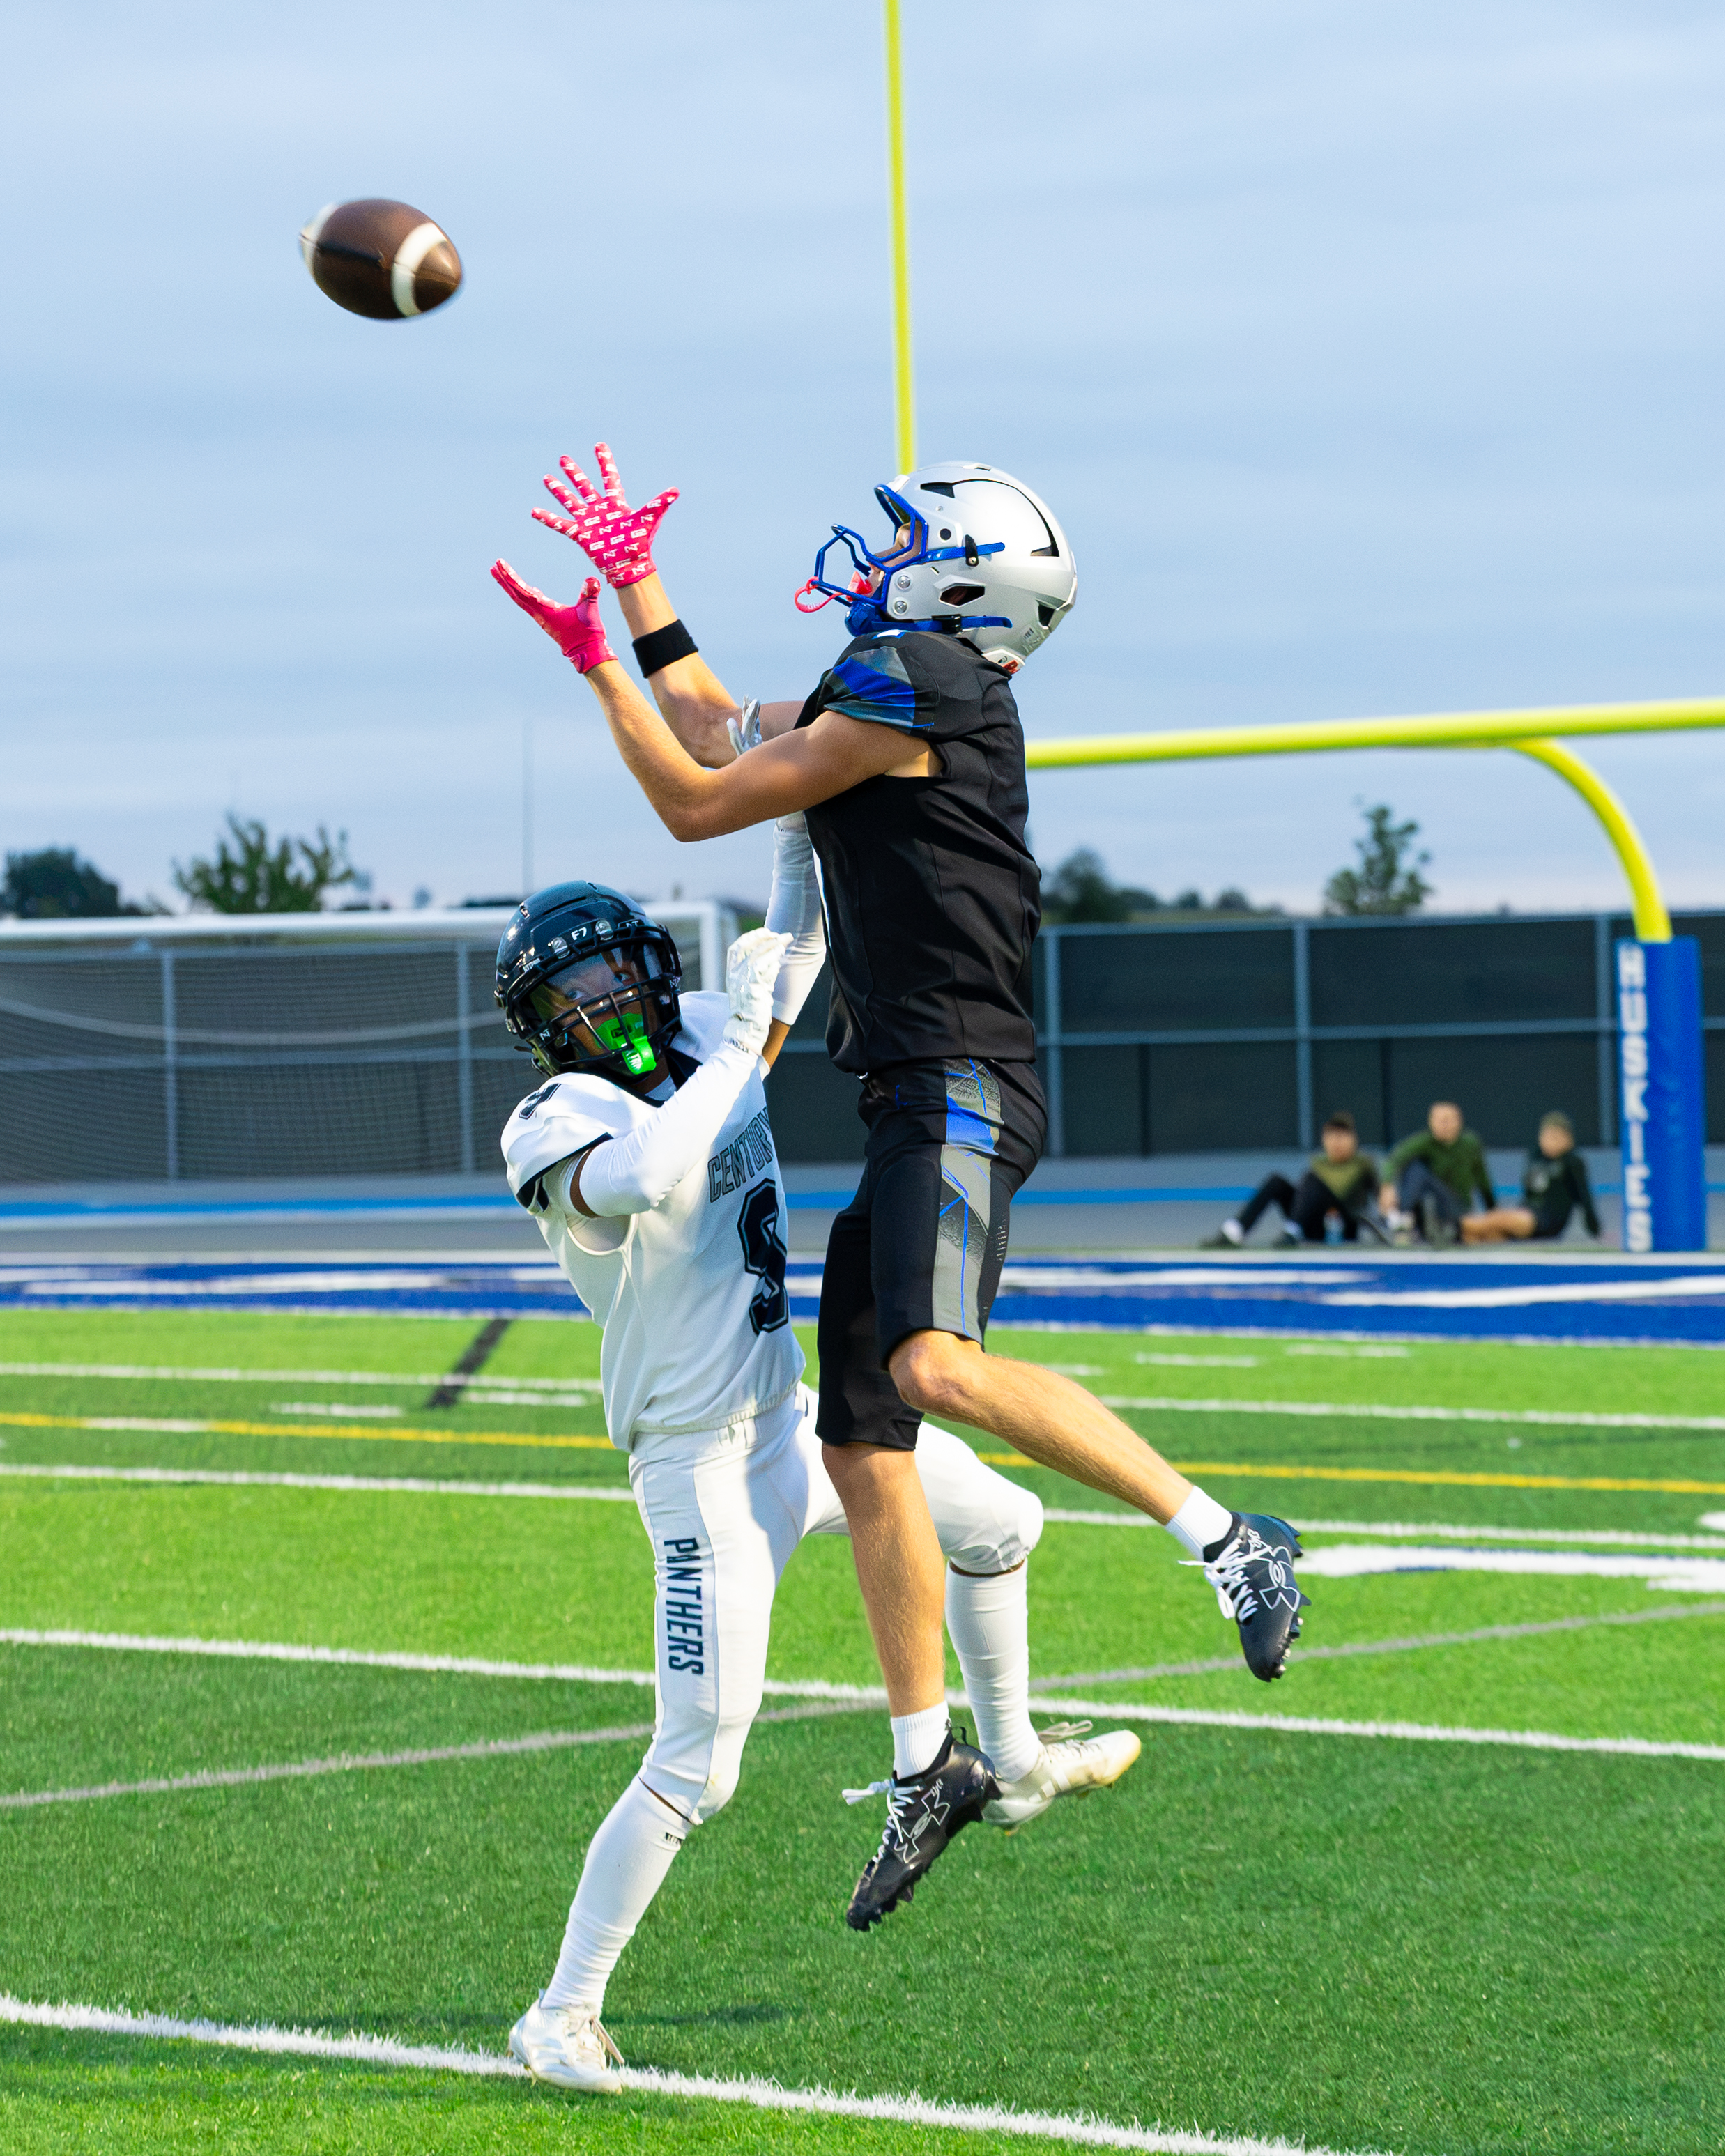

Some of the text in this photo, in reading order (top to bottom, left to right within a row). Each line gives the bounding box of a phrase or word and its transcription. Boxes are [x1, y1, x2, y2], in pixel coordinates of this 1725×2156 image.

[570, 926, 588, 941] F7
[1618, 944, 1652, 1252] HUSKIES
[737, 1177, 789, 1337] 9
[664, 1537, 705, 1676] PANTHERS
